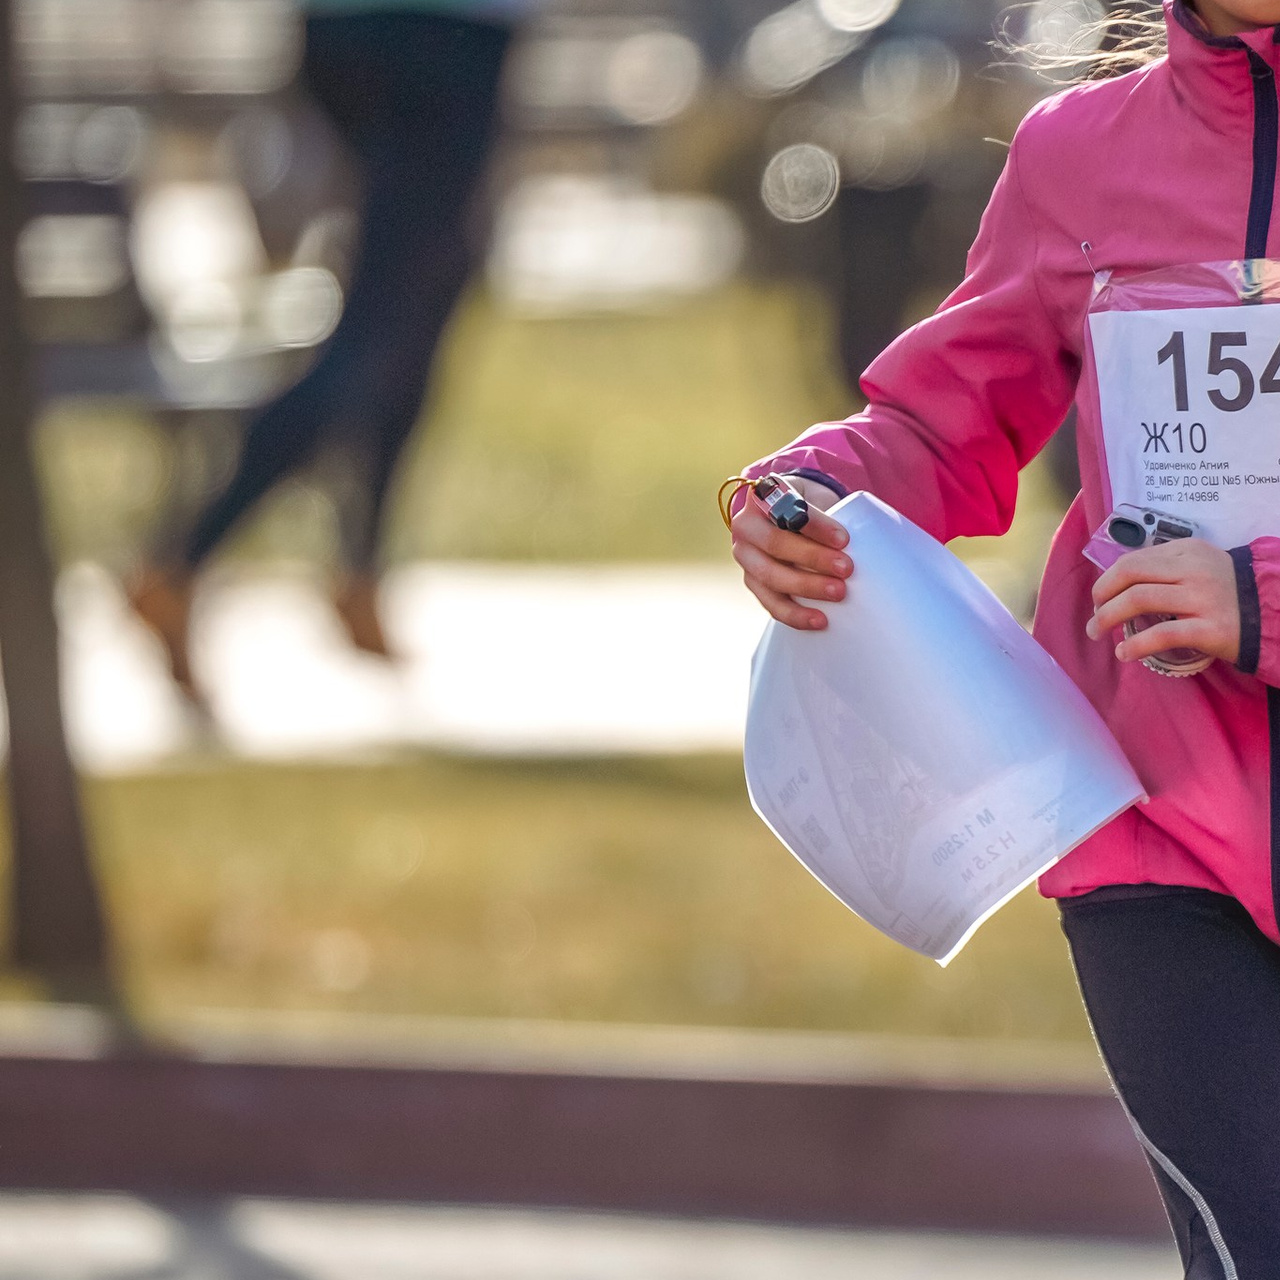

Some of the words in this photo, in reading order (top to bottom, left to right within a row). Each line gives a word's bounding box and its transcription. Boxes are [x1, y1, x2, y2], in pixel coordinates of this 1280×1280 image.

[1140, 422, 1208, 454] Ж10
[1143, 459, 1197, 471] Удовиченко
[1199, 459, 1230, 470] Агния
[1144, 475, 1179, 488] 26_МБУ
[1182, 475, 1198, 488] ДО
[1200, 475, 1219, 487] СШ
[1222, 474, 1241, 486] №5
[1244, 473, 1280, 484] Южны
[1146, 491, 1175, 502] SI-чип:
[1177, 491, 1220, 502] 2149696
